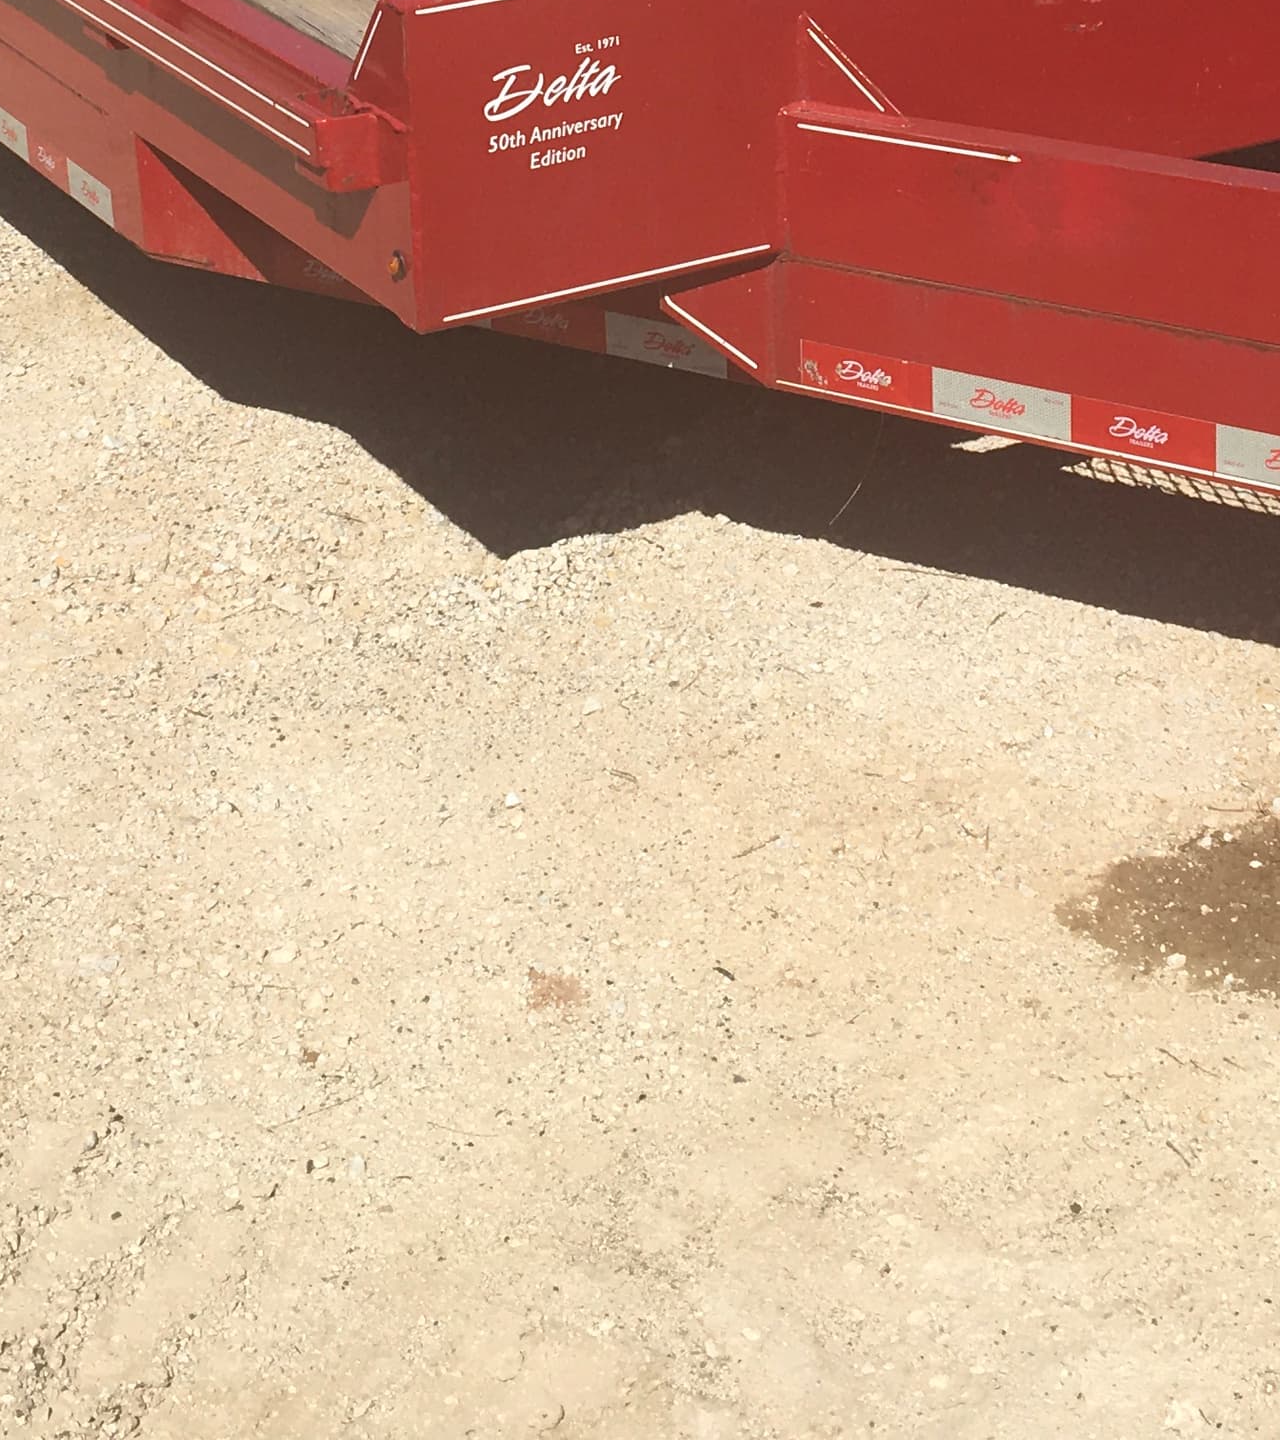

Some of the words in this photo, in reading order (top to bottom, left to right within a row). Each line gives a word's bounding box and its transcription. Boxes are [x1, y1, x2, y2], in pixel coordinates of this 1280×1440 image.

[575, 42, 594, 55] Est.
[597, 35, 621, 50] 1971
[483, 56, 622, 122] Delta
[488, 131, 526, 153] 50th
[529, 111, 623, 145] Anniversary
[529, 146, 587, 170] Edition
